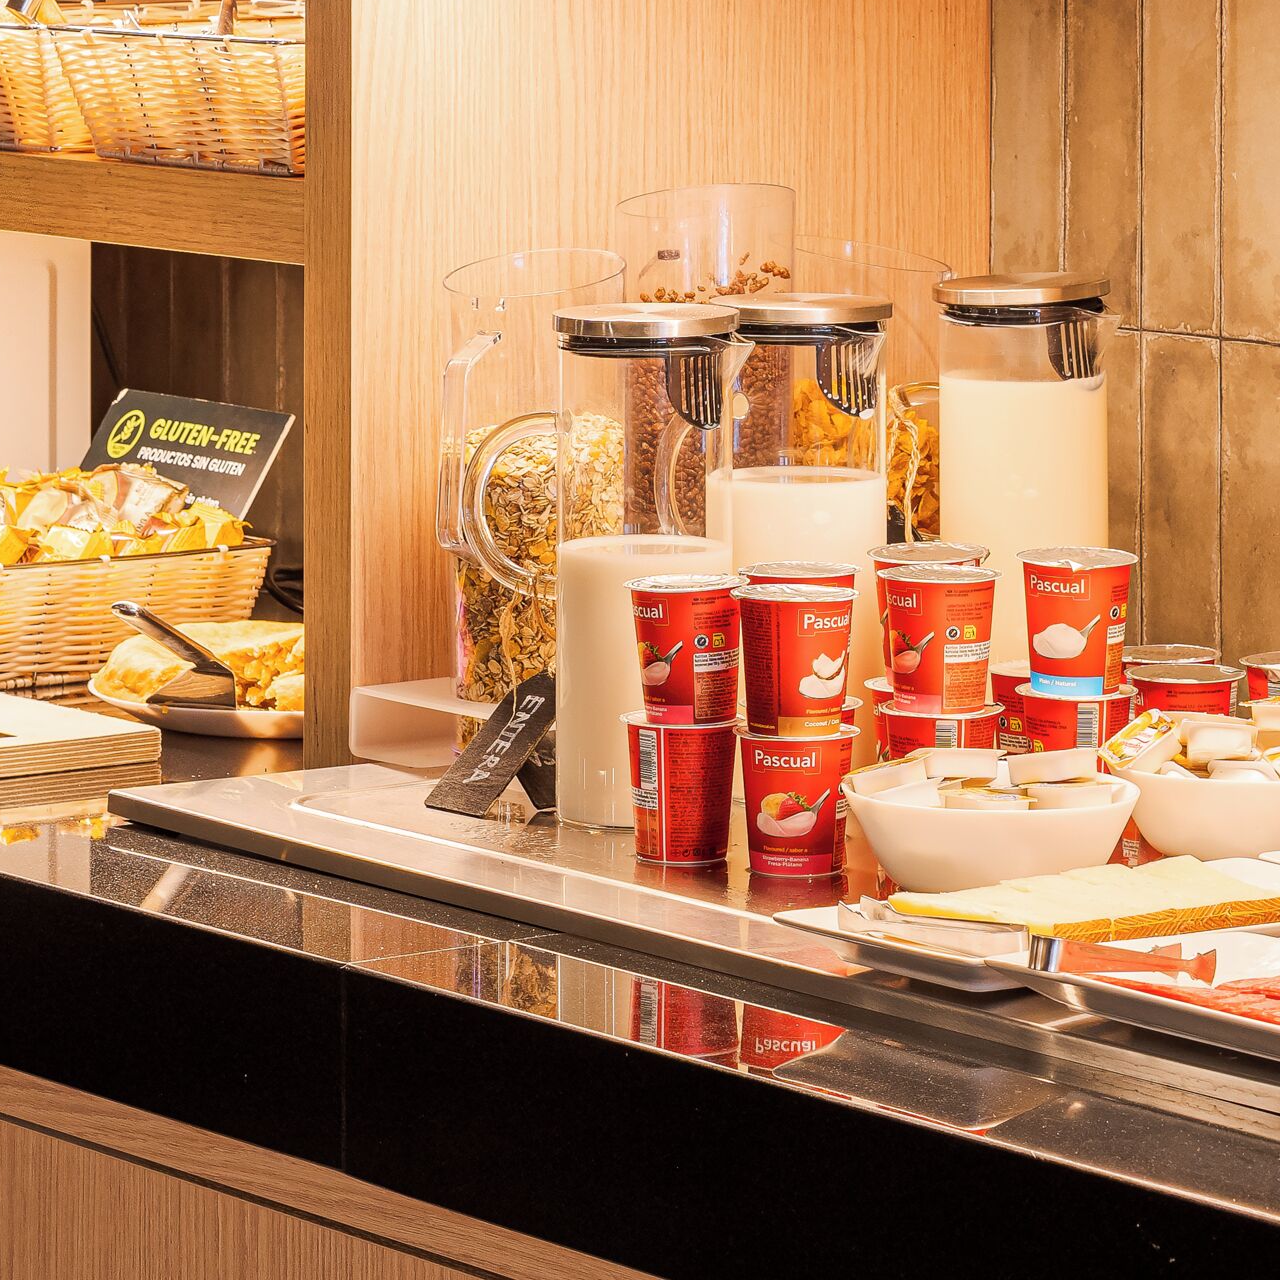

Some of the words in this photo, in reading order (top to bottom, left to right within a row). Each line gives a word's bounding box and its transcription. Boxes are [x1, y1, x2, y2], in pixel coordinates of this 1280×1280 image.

[149, 418, 261, 455] GLUTEN-FREE
[137, 446, 191, 469] PRODUCTOS
[191, 456, 209, 470] SIN
[208, 458, 246, 477] GLUTEN
[1030, 574, 1085, 594] Pascual
[803, 609, 851, 630] Pascual
[462, 695, 545, 784] ENTERA
[754, 749, 816, 768] Pascual
